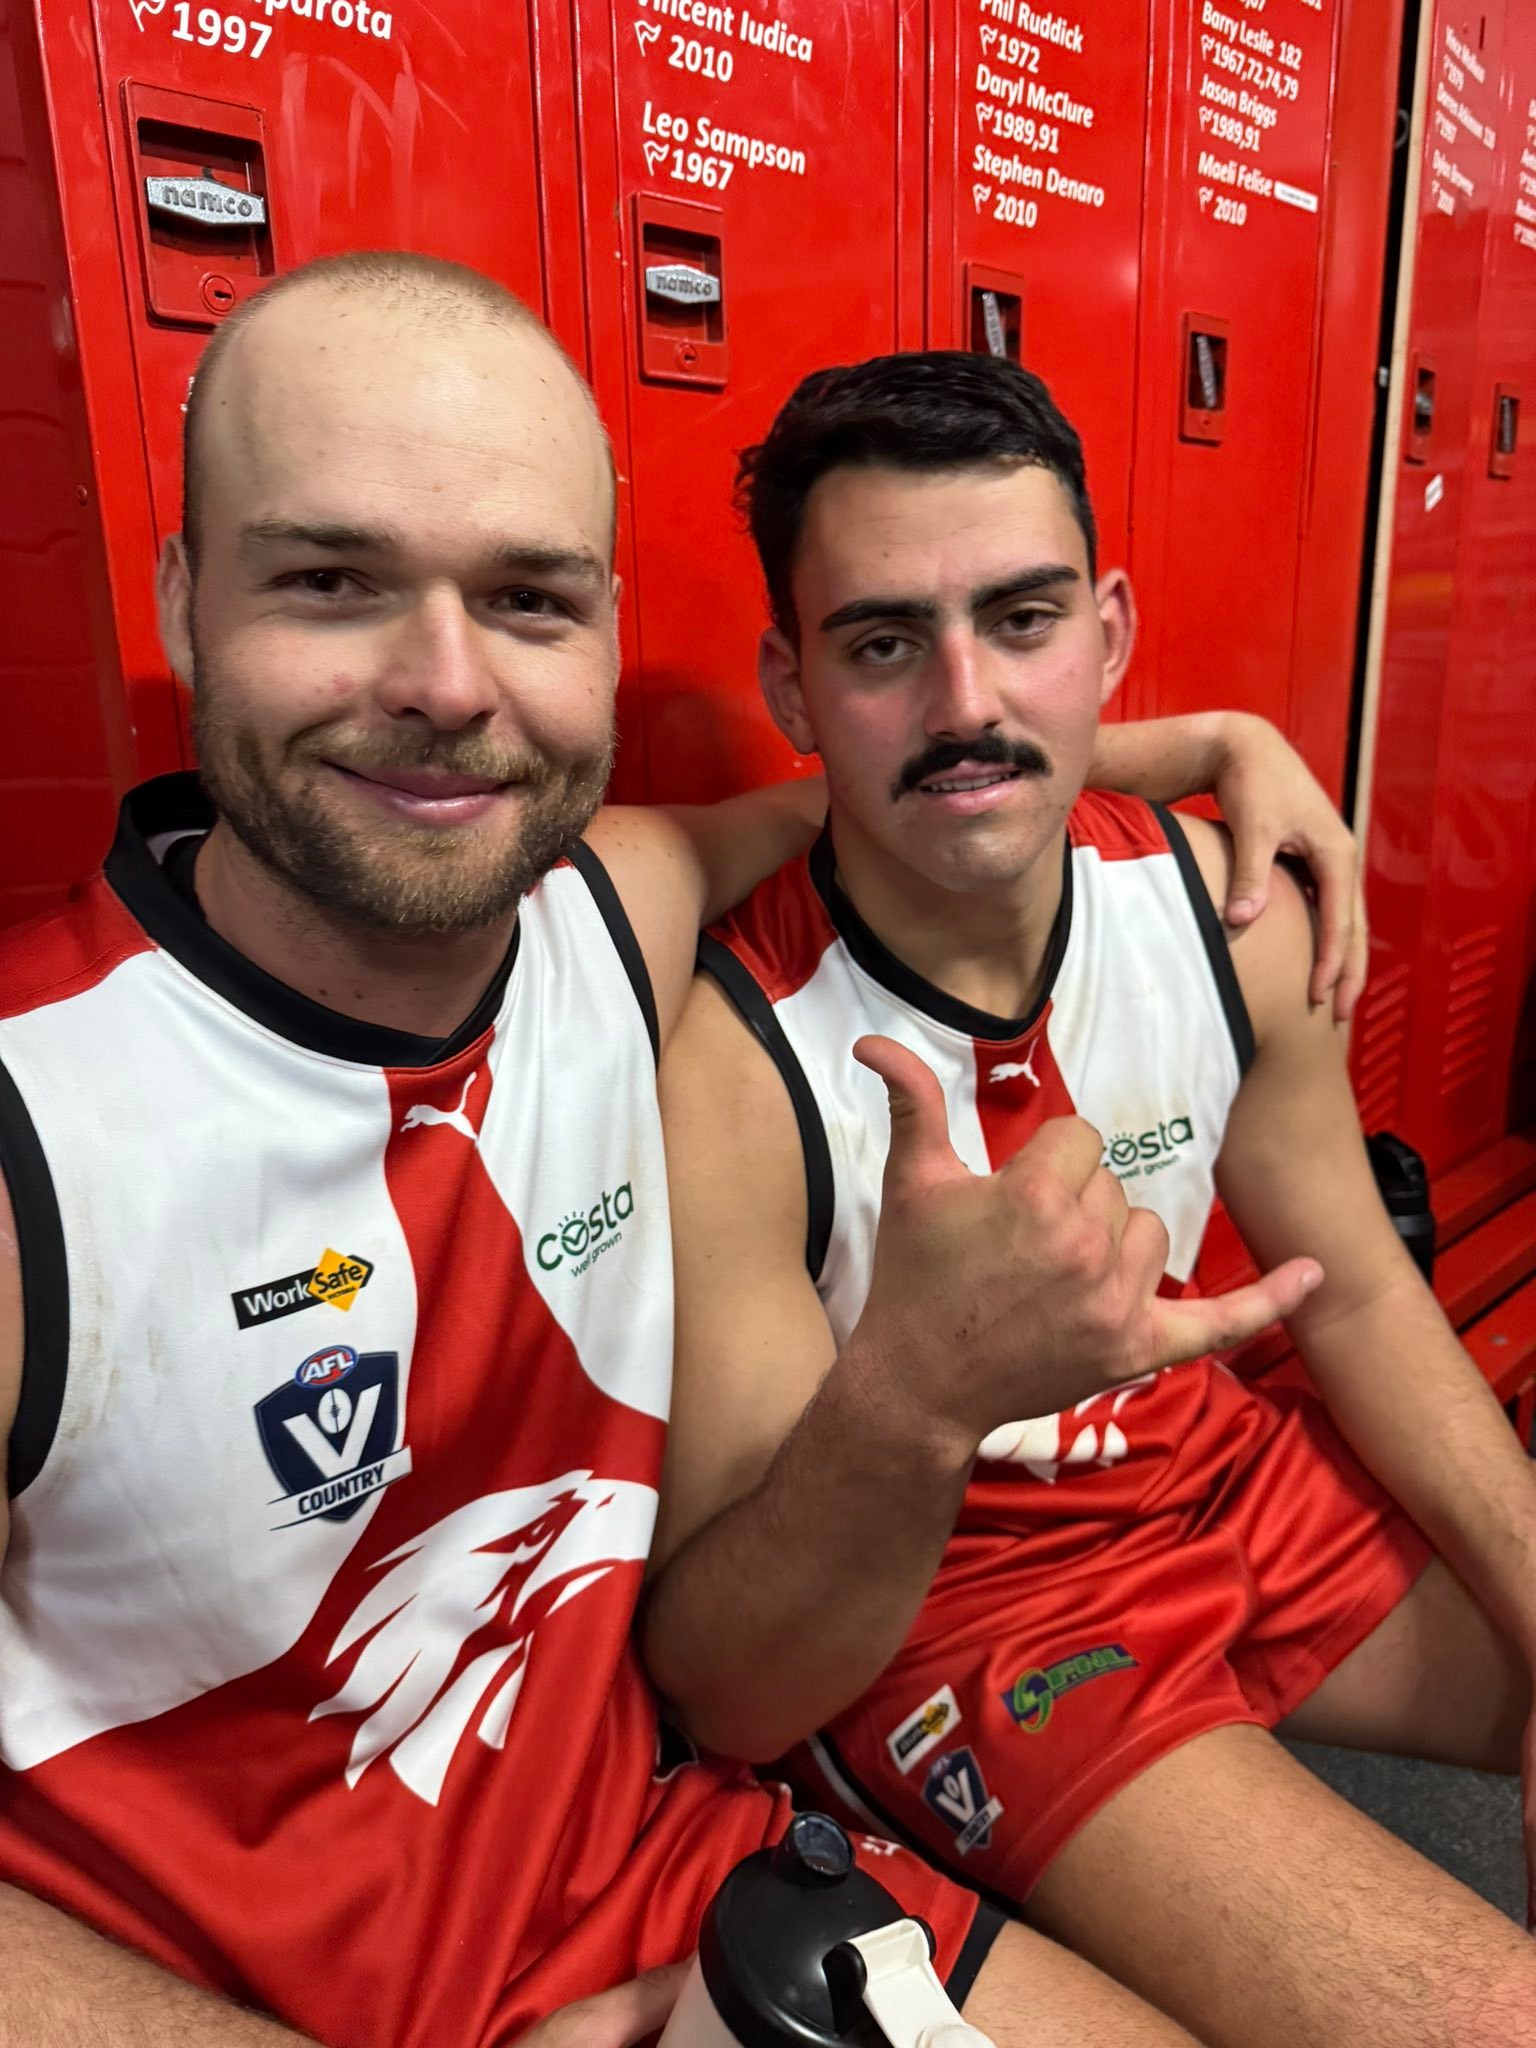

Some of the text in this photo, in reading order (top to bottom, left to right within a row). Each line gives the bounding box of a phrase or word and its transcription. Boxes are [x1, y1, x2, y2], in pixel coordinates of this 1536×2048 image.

[171, 1, 273, 59] 1997
[254, 0, 393, 40] parota
[637, 0, 735, 37] ncent
[1017, 1, 1084, 54] Ruddick
[1201, 0, 1303, 71] Barry Leslie 182
[667, 34, 734, 83] 2010
[996, 33, 1041, 74] 1972
[1212, 41, 1299, 101] 1967,72,74,79
[976, 63, 1094, 128] Daryl McClure
[1199, 73, 1278, 129] Jason Briggs
[642, 101, 806, 175] Leo Sampson
[992, 109, 1059, 154] 1989,91
[1210, 111, 1261, 152] 1989,91
[669, 149, 734, 191] 1967
[973, 143, 1105, 208] Stephen Denaro
[162, 185, 252, 217] namco
[993, 192, 1038, 228] 2010
[1213, 195, 1247, 226] 2010
[656, 274, 712, 297] namco
[1103, 1116, 1194, 1166] osta
[592, 1232, 622, 1263] grown
[301, 1349, 354, 1384] AFL
[282, 1382, 383, 1480] V
[298, 1463, 386, 1516] COUNTRY
